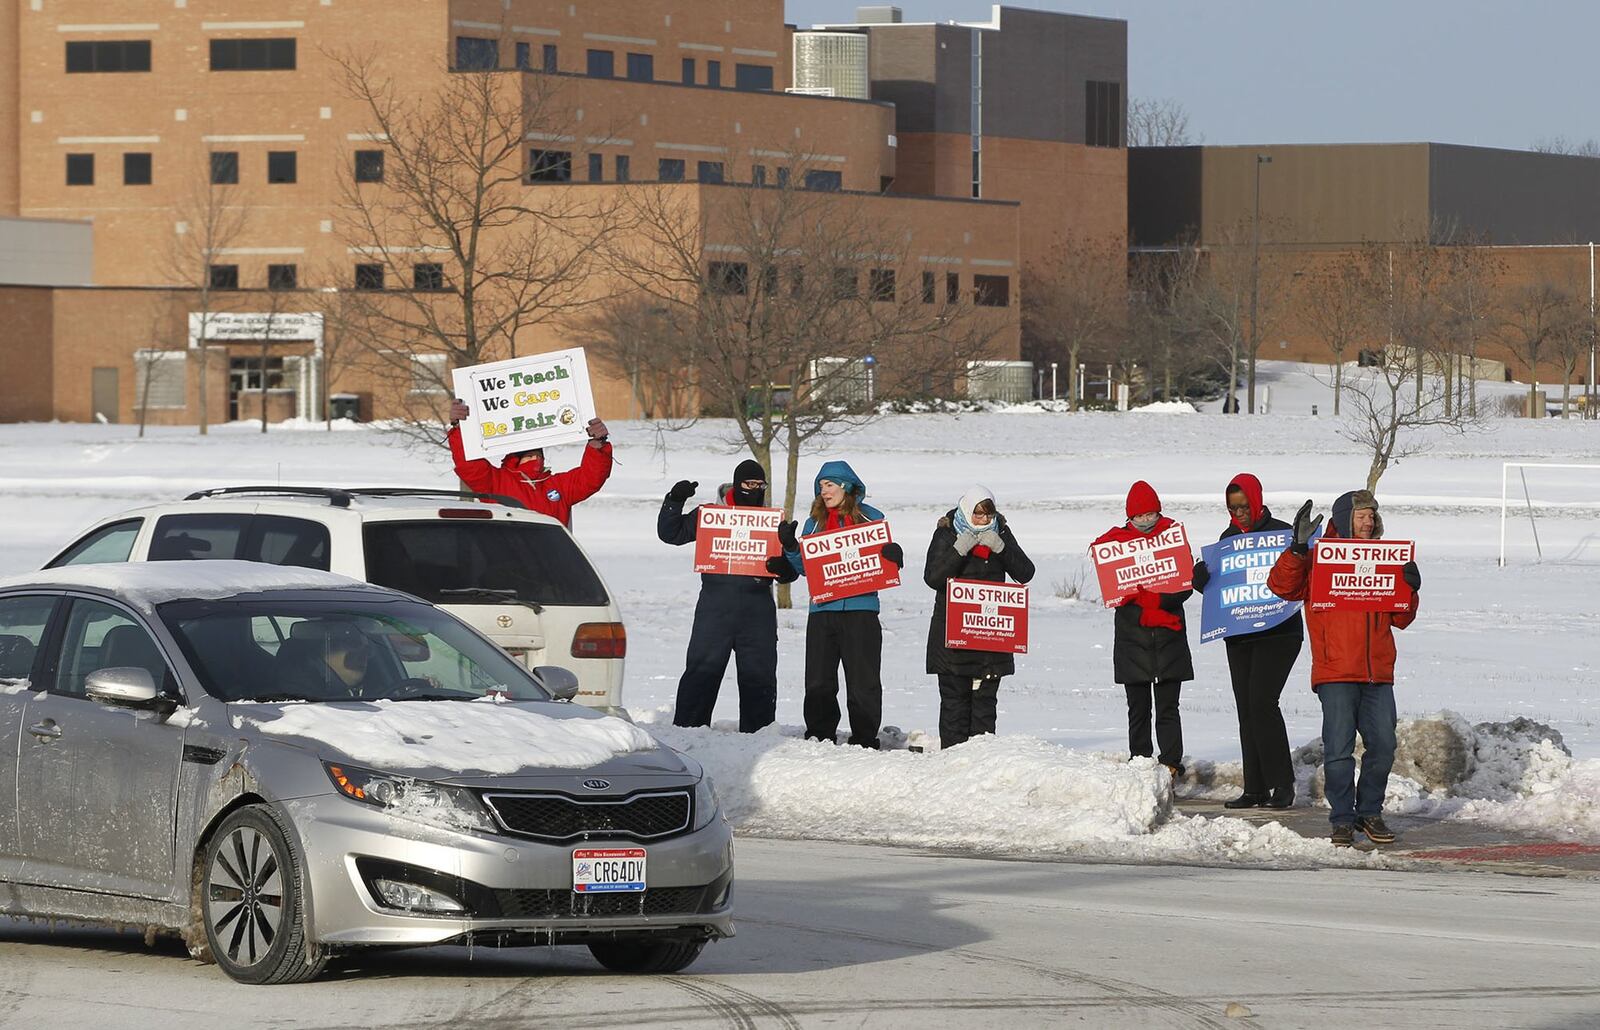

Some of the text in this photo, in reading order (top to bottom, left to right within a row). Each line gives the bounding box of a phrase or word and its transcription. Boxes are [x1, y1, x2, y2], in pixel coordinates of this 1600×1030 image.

[479, 365, 570, 392] We Teach
[482, 389, 560, 411] We Care
[481, 412, 556, 437] Be Fair
[703, 512, 779, 528] ON STRIKE
[735, 529, 747, 538] for
[806, 528, 887, 554] ON STRIKE
[714, 540, 765, 553] WRIGHT
[1099, 531, 1182, 559] ON STRIKE
[1232, 535, 1286, 551] WE ARE
[844, 550, 857, 560] for
[1139, 554, 1150, 563] for
[1222, 551, 1280, 572] FIGHTI
[1320, 547, 1409, 561] ON STRIKE
[825, 556, 878, 577] WRIGHT
[1118, 559, 1173, 581] WRIGHT
[1359, 565, 1372, 574] for
[1334, 575, 1393, 588] WRIGHT
[953, 587, 1024, 605] ON STRIKE
[1222, 585, 1279, 605] WRIG
[984, 606, 995, 614] for
[1231, 600, 1289, 615] #fighting4wright
[965, 614, 1013, 629] WRIGHT
[588, 780, 607, 789] KIA
